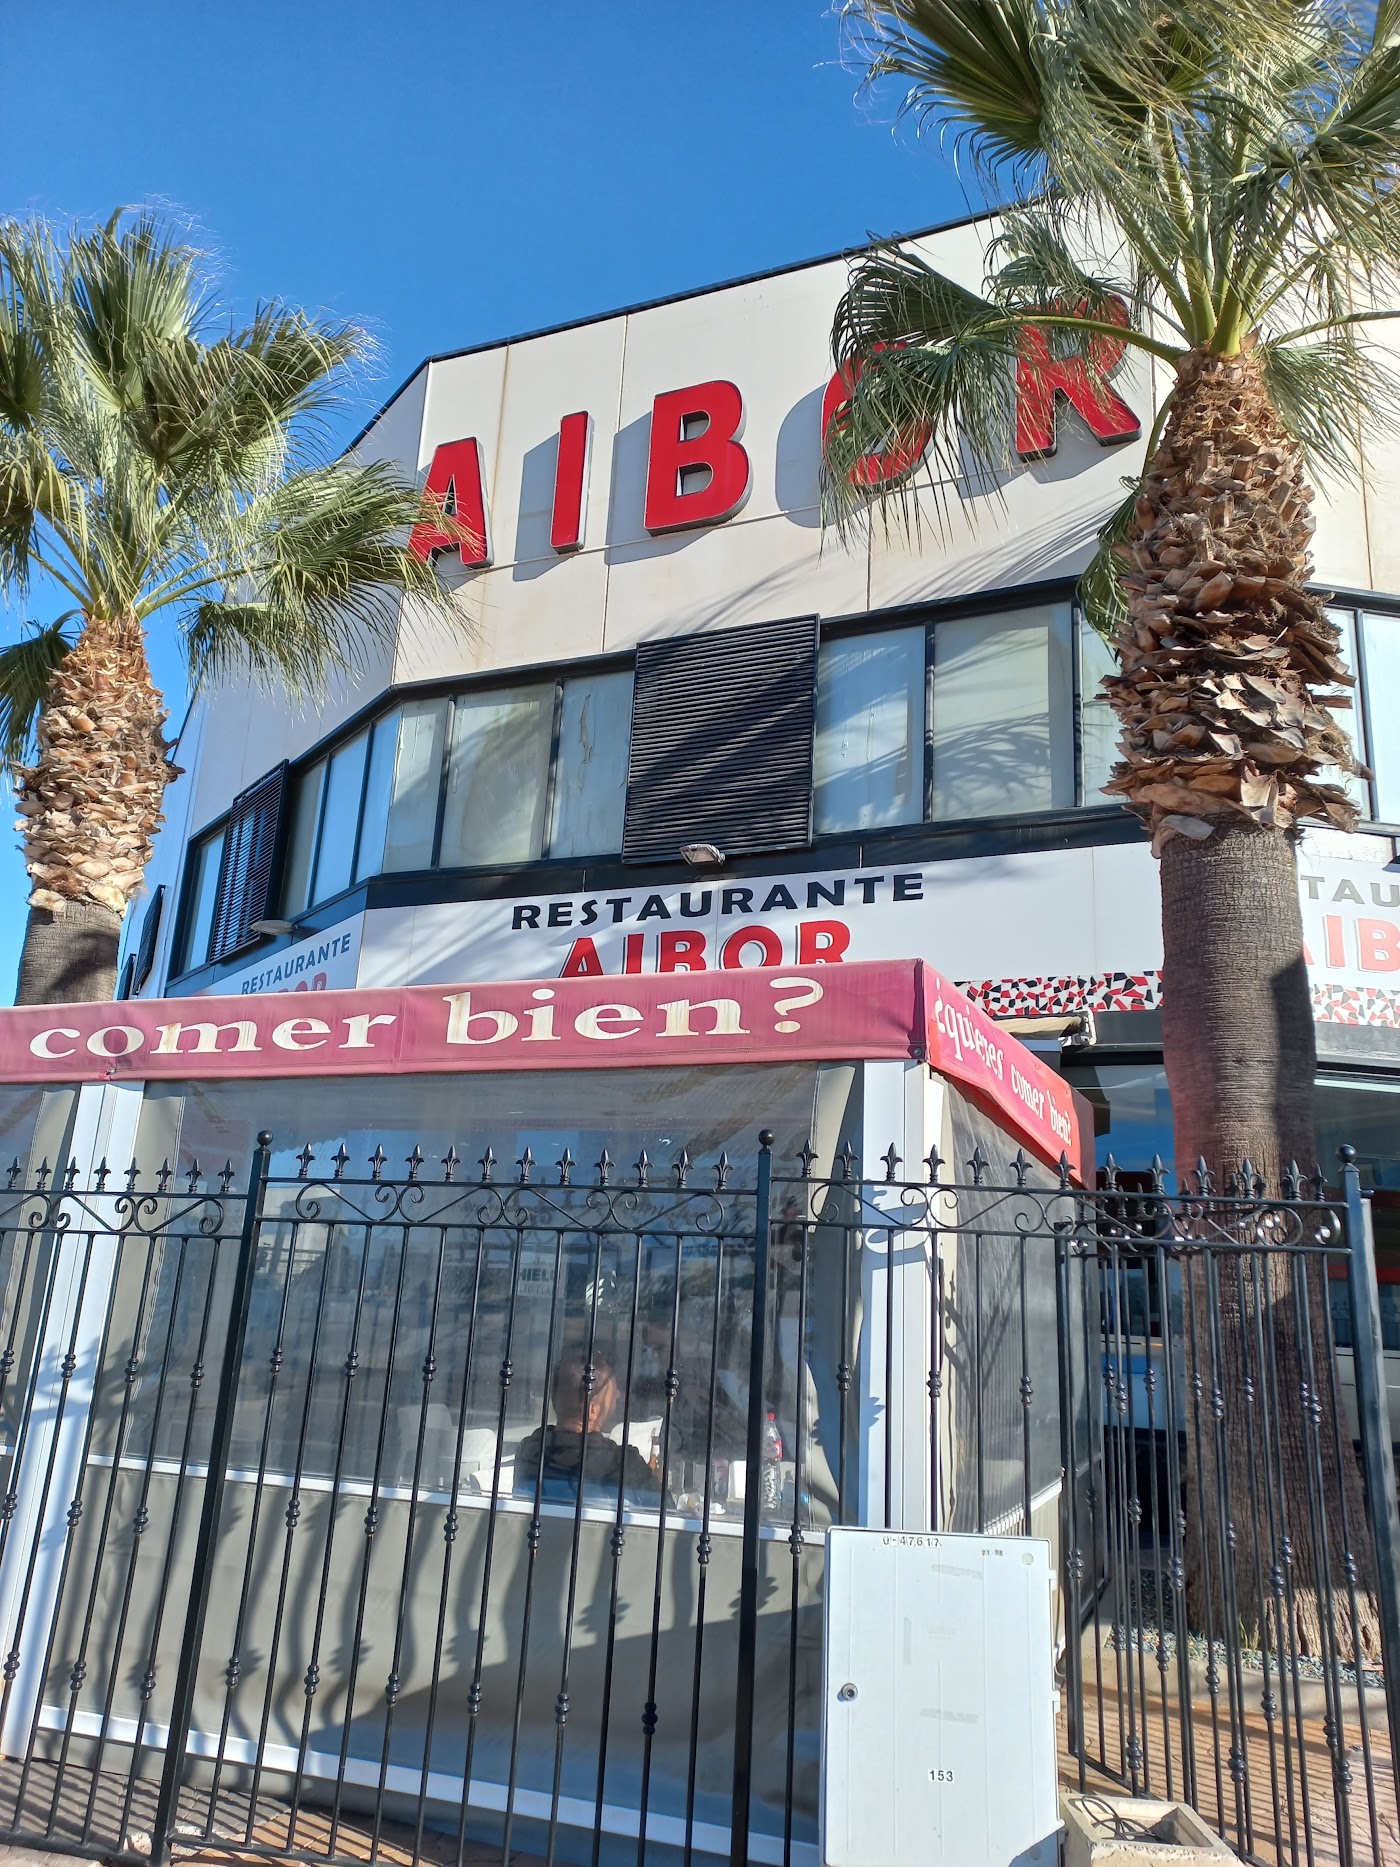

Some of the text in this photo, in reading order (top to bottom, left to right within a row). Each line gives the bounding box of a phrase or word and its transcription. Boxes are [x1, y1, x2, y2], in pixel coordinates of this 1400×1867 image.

[511, 872, 924, 930] RESTAURANTE
[241, 932, 351, 995] RESTAURANTE
[560, 919, 852, 978] AIBOR
[29, 975, 825, 1059] comer bien?
[934, 976, 1073, 1147] ¿quieres comer bien?
[929, 1770, 954, 1782] 153
